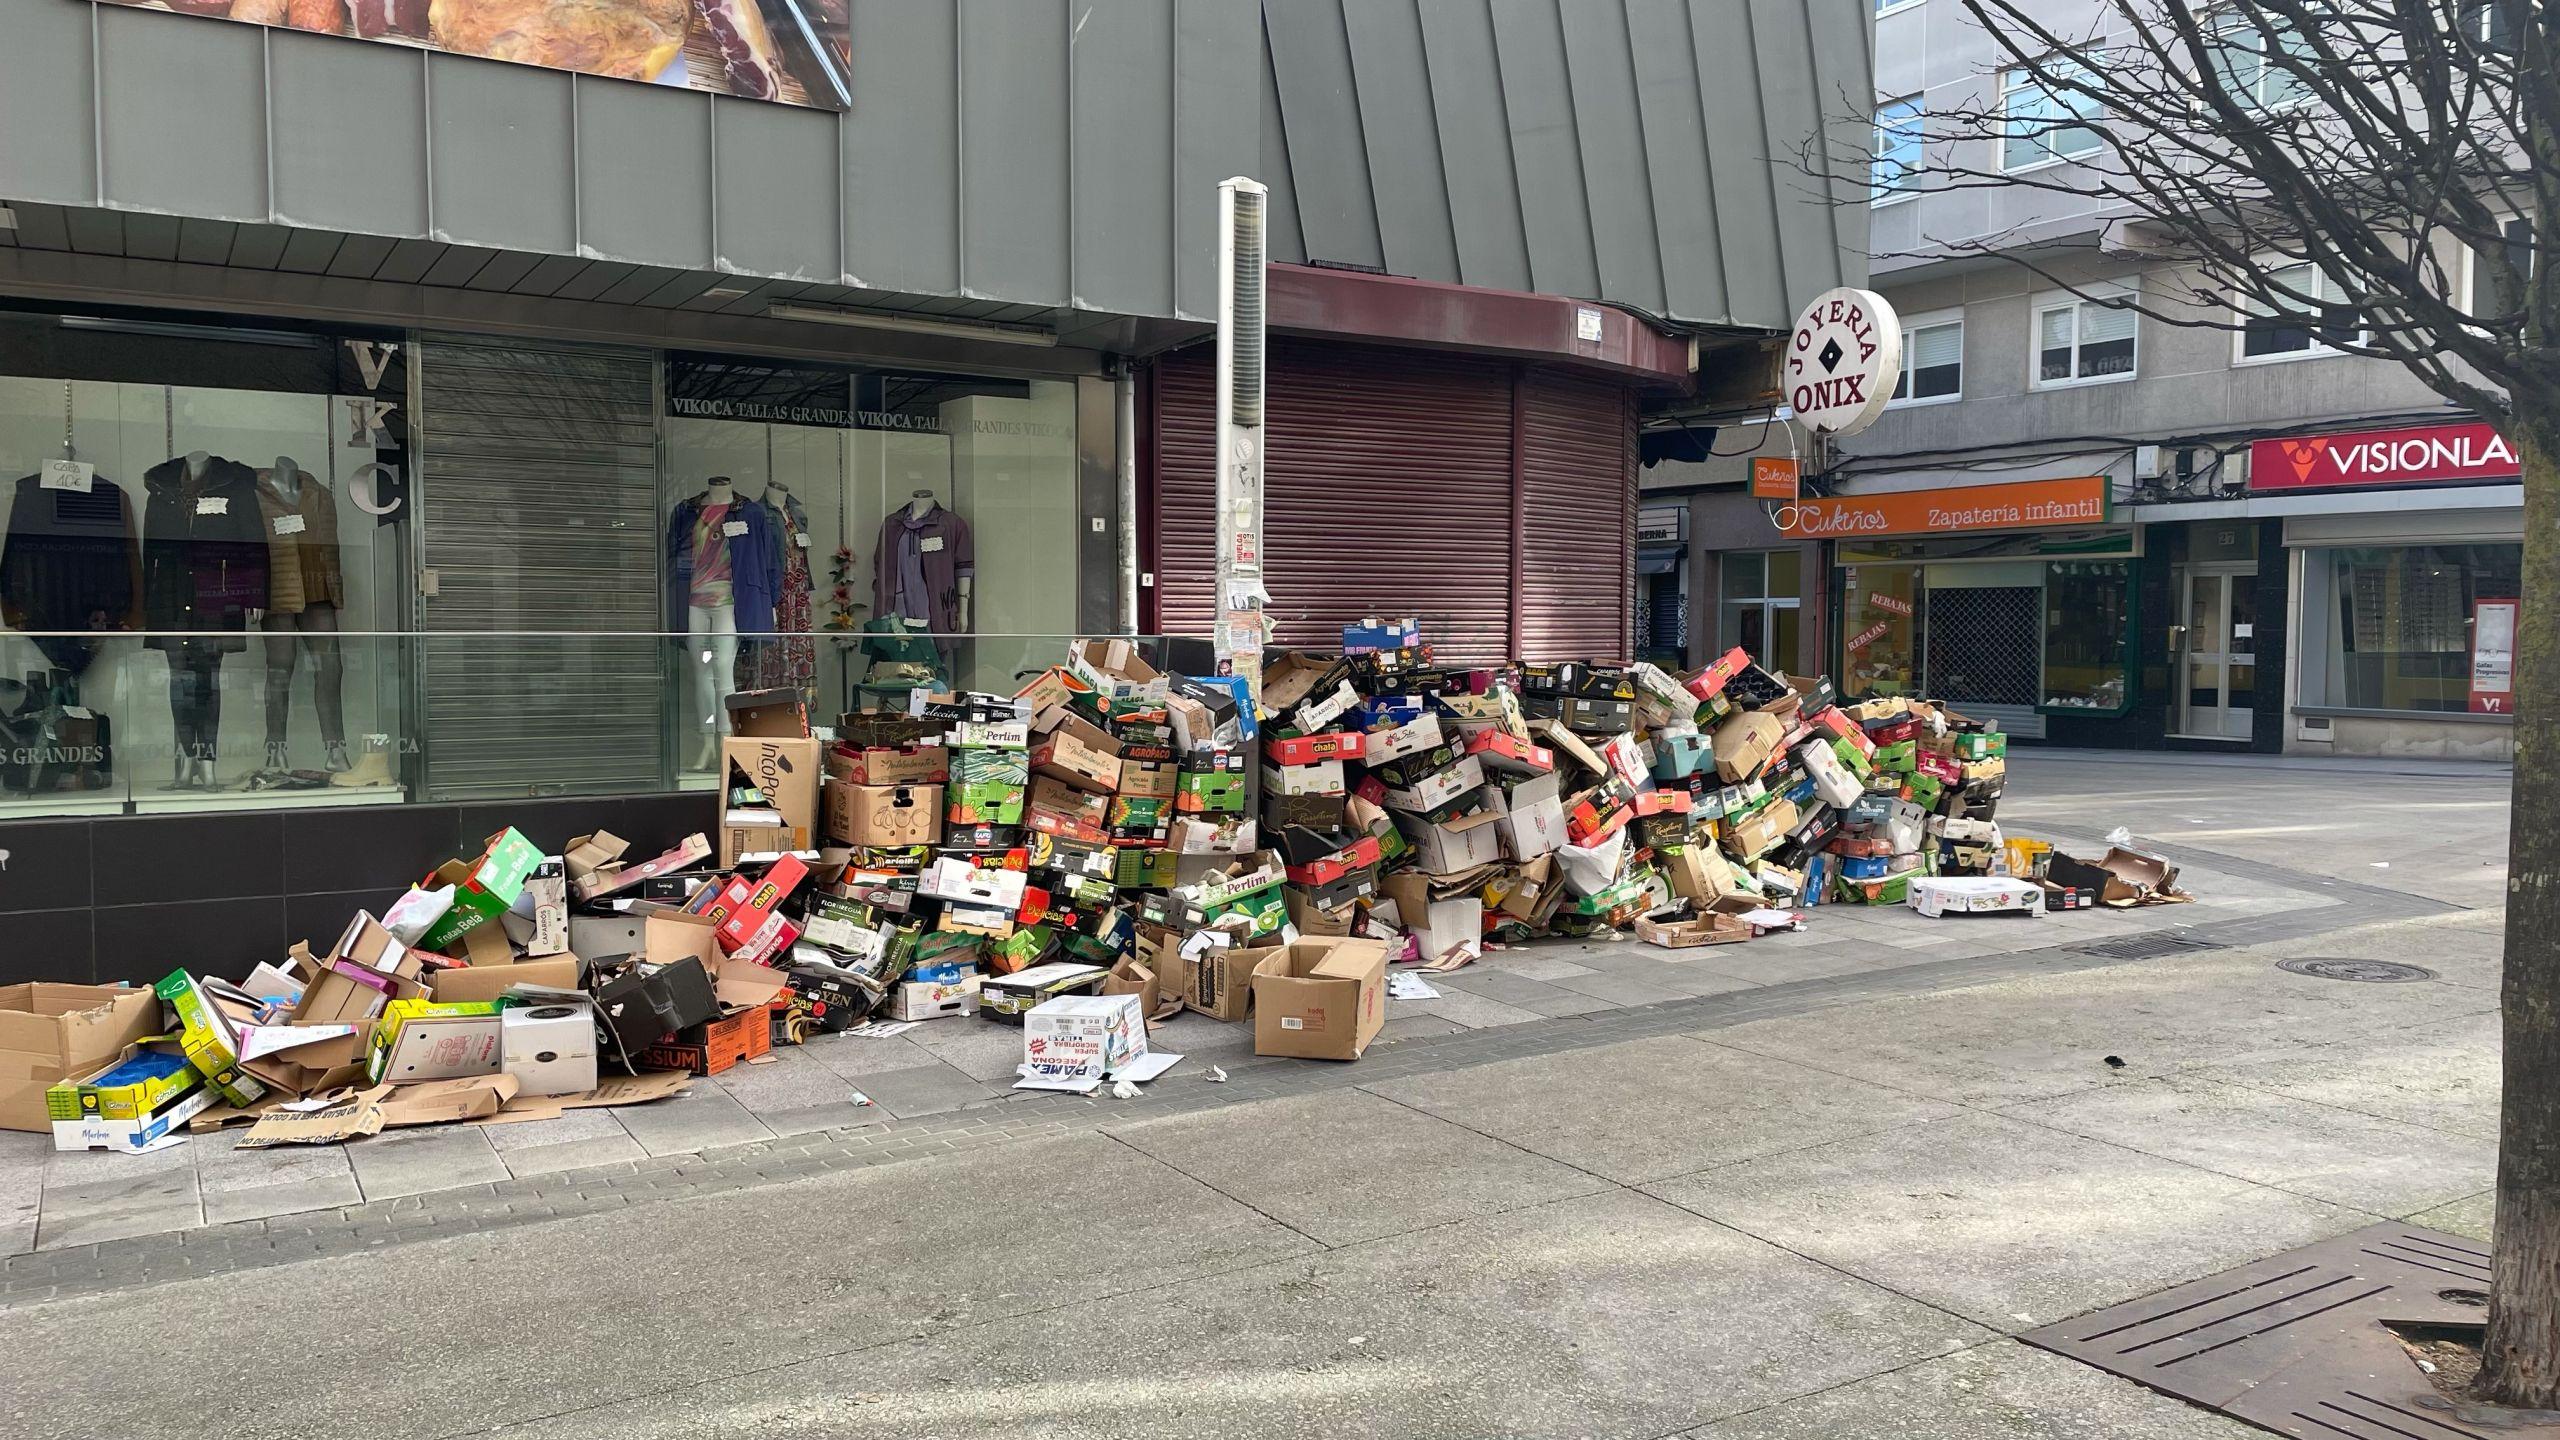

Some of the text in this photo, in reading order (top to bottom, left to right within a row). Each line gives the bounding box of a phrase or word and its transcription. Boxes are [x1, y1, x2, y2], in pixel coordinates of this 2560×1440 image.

[1789, 300, 1877, 376] JOYERIA
[1793, 373, 1866, 414] ONIX
[672, 398, 734, 417] VIKOCA
[735, 402, 788, 420] TALLAS
[791, 406, 855, 426] GRANDES
[857, 411, 912, 430] VIKOCA
[2329, 432, 2520, 475] VISIONLA
[1798, 497, 2102, 534] Cukiños Zapatería infantil
[2217, 531, 2236, 545] 27
[1870, 592, 1912, 615] REBAJAS
[1847, 620, 1887, 651] REBAJAS
[985, 730, 1022, 743] Perlim
[12, 744, 104, 765] GRANDES
[1129, 746, 1170, 760] AGROPACO
[760, 742, 782, 811] IncoPac
[1226, 873, 1268, 896] Perlim
[437, 912, 484, 945] Frutas Bela
[261, 1113, 287, 1121] GOLPE
[324, 1109, 346, 1119] DEJAR
